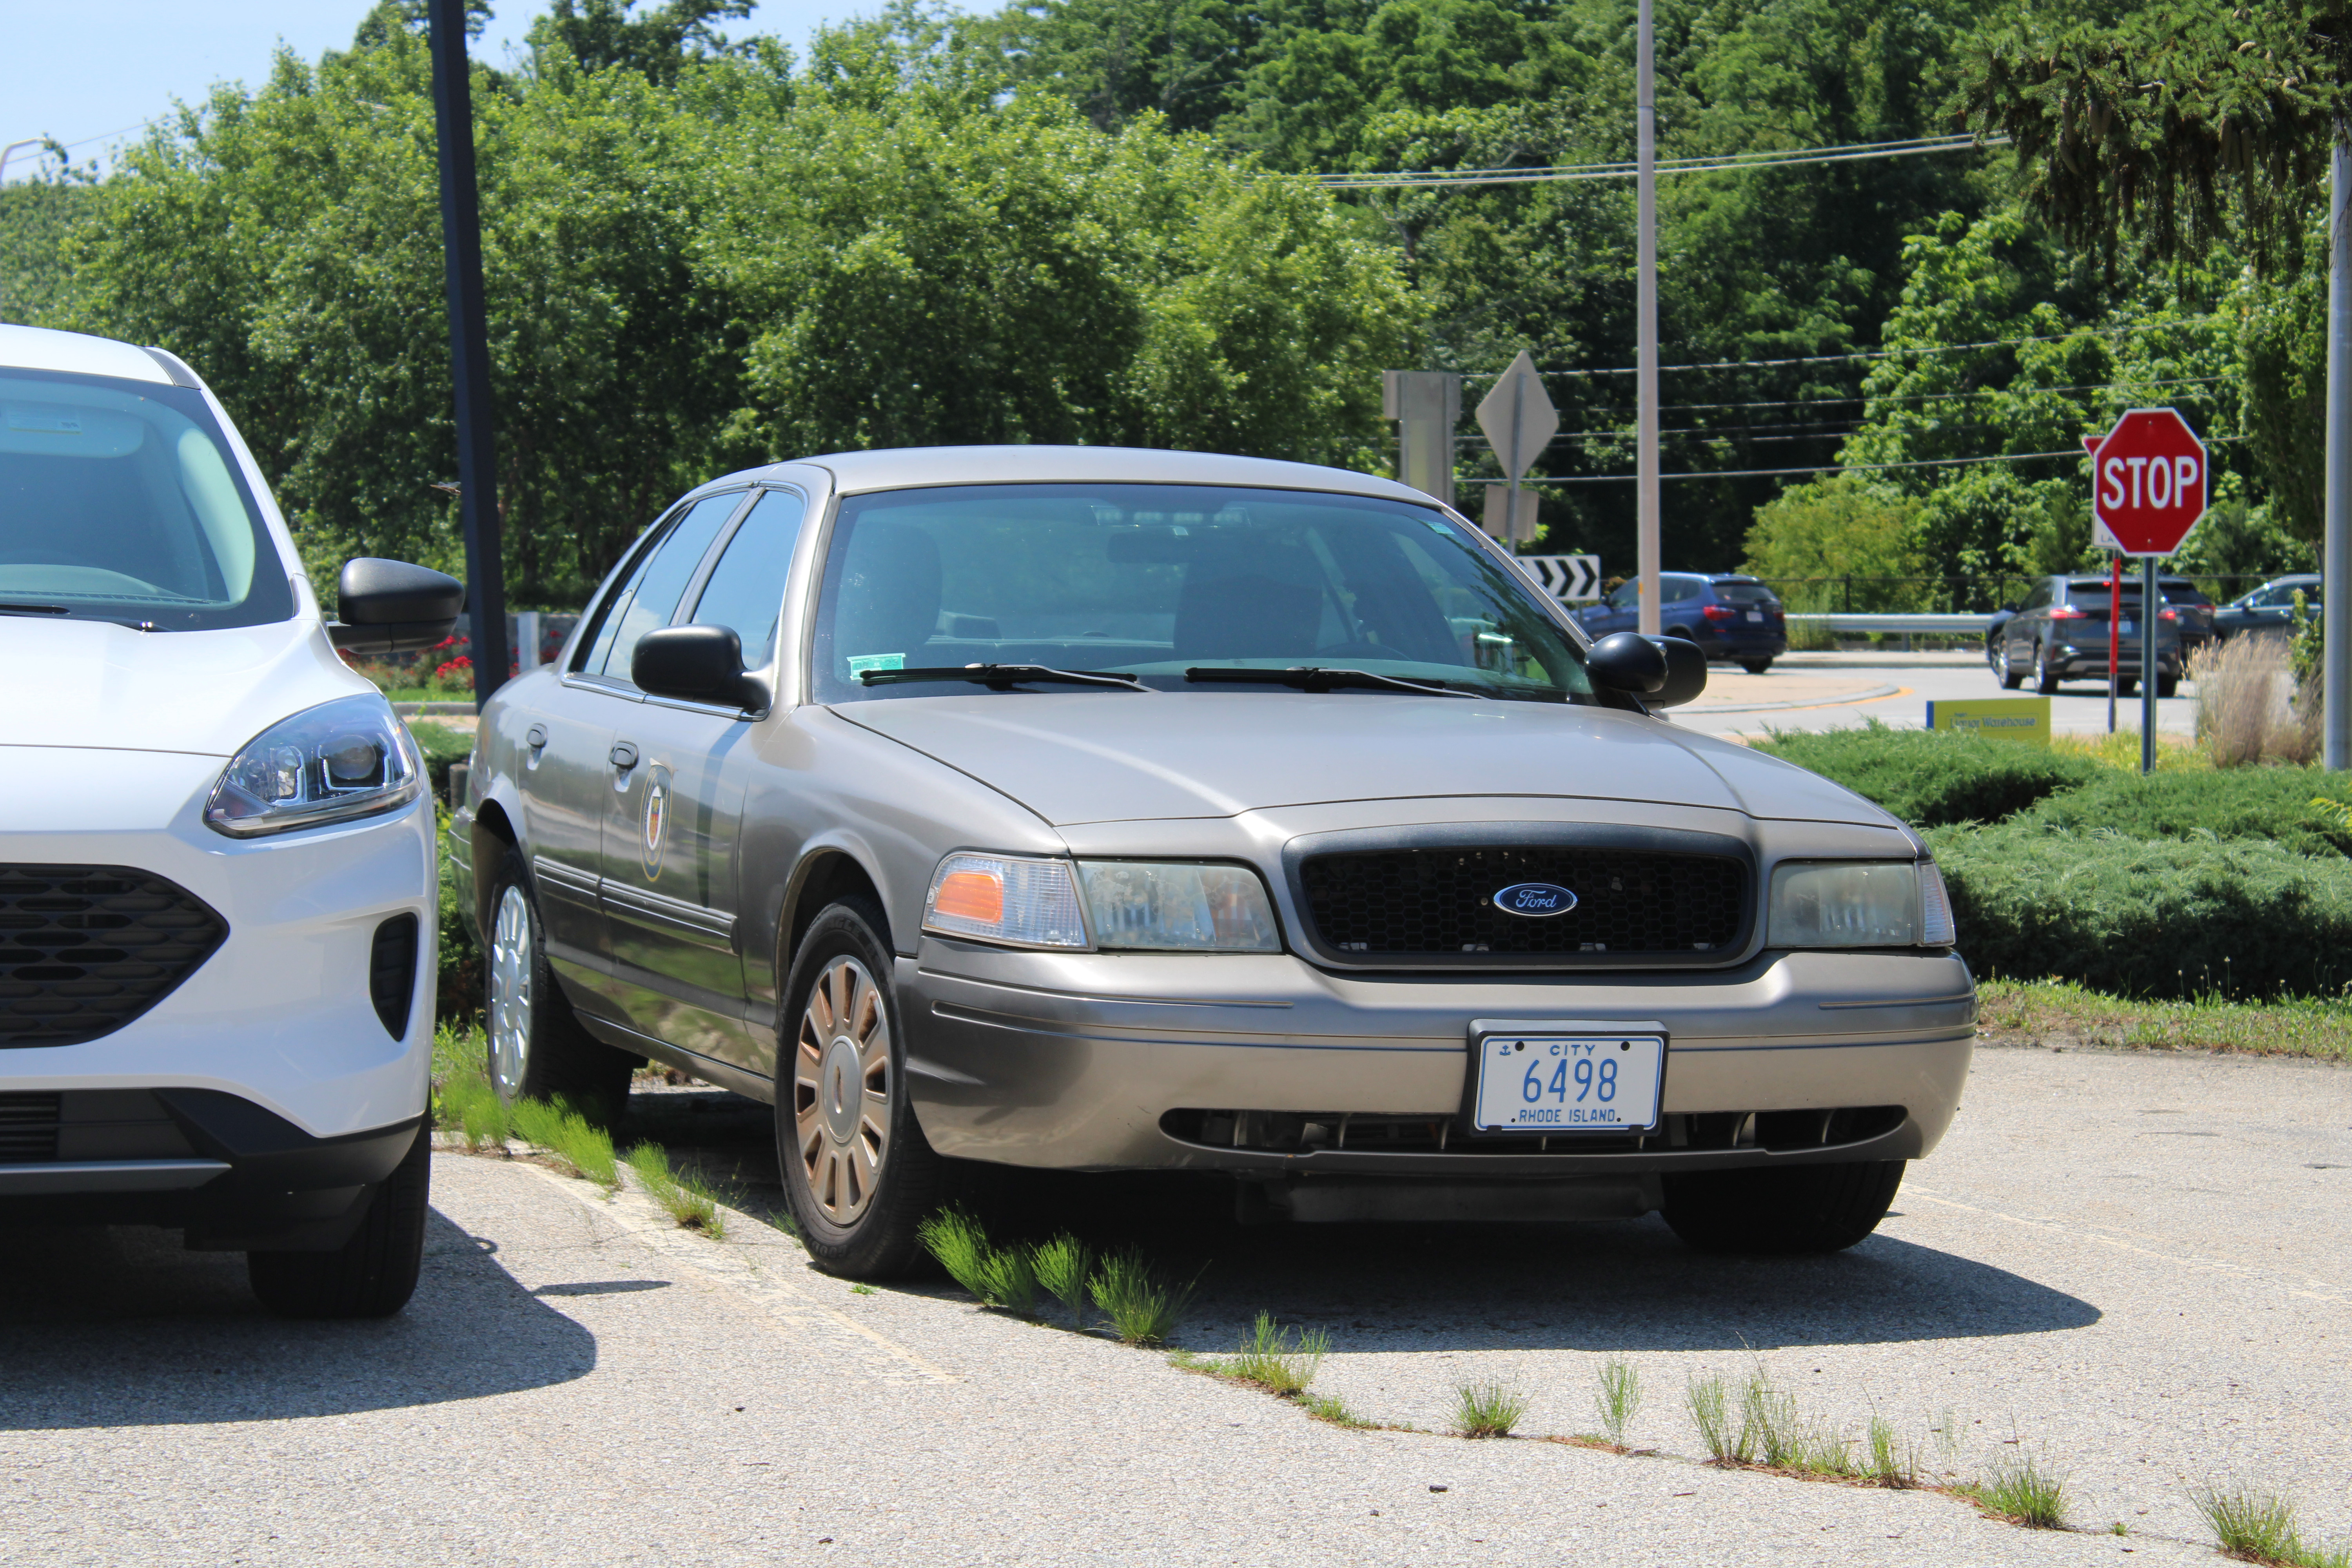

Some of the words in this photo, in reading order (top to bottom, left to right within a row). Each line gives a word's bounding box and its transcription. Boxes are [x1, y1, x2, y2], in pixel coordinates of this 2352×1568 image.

[2102, 455, 2198, 510] STOP
[1950, 718, 1980, 730] Liquor
[1982, 717, 2035, 728] Warehouse
[1515, 889, 1557, 907] Ford
[1550, 1045, 1595, 1056] CITY
[1523, 1059, 1618, 1103] 6498
[1519, 1109, 1562, 1122] RHODE
[1569, 1109, 1615, 1122] ISLAND
